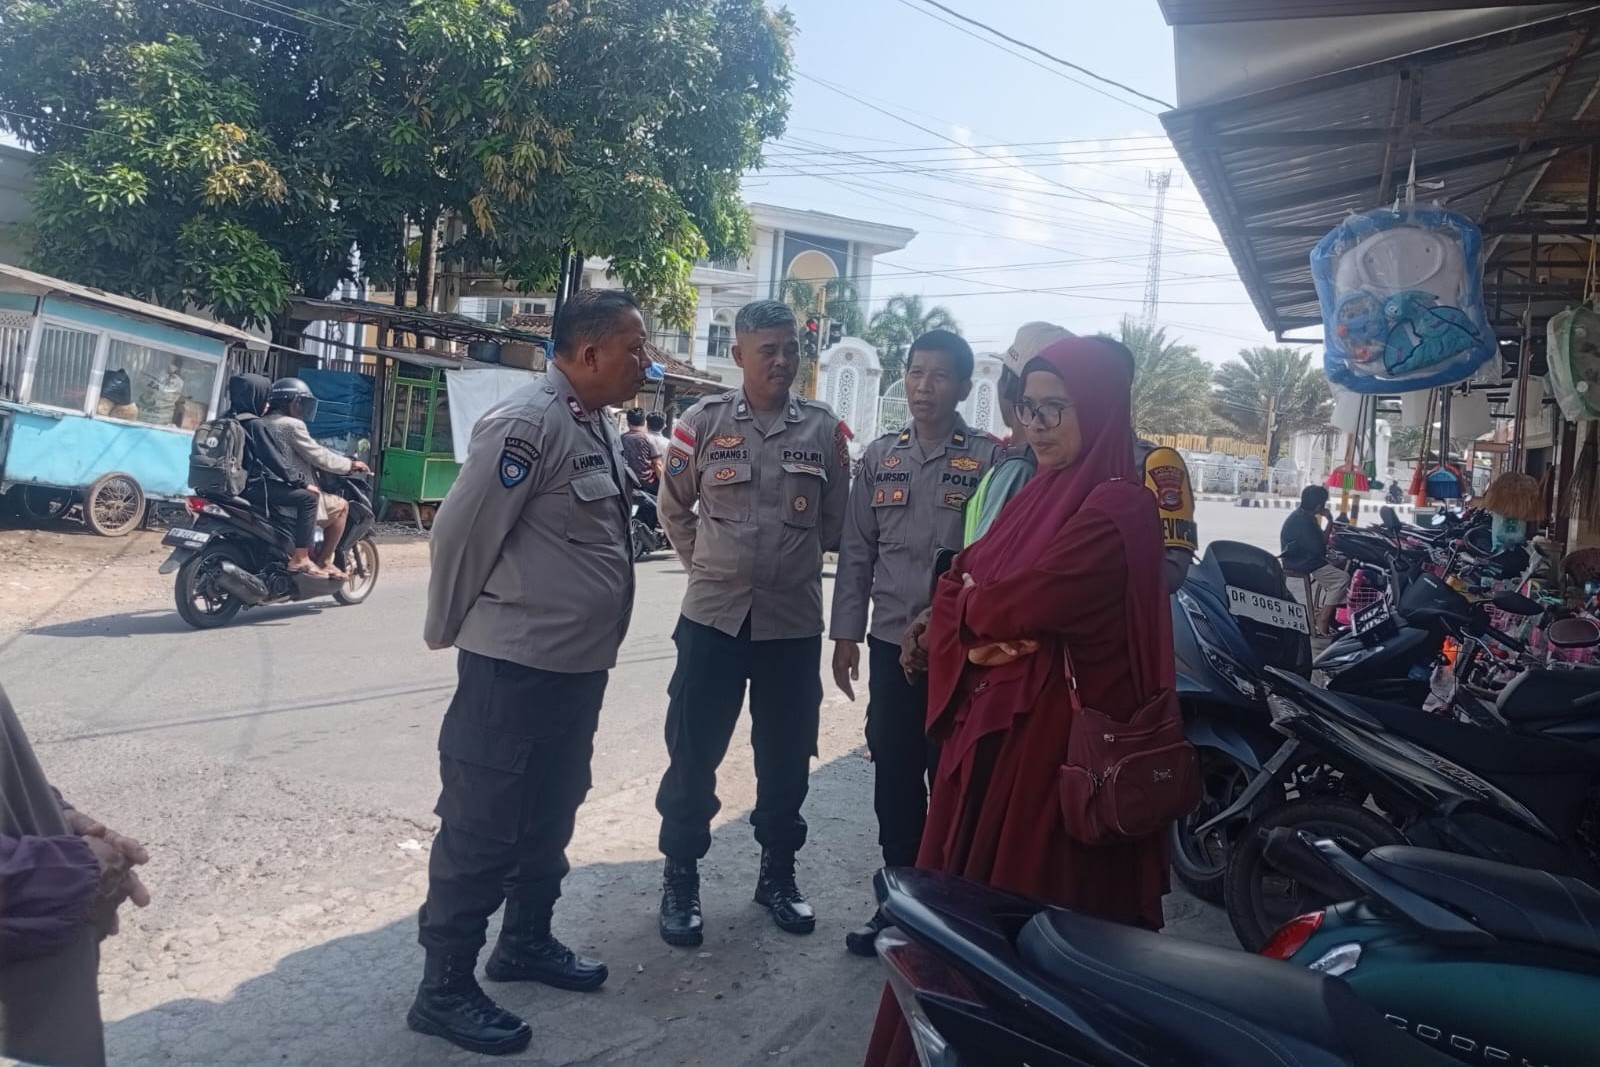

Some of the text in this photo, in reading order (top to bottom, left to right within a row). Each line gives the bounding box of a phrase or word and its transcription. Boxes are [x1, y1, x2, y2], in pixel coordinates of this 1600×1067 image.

[710, 451, 741, 461] KOMANG
[742, 451, 748, 459] S
[784, 450, 822, 462] POLRI
[942, 473, 980, 488] POLR
[1231, 589, 1247, 604] DR
[1251, 592, 1282, 613] 3065
